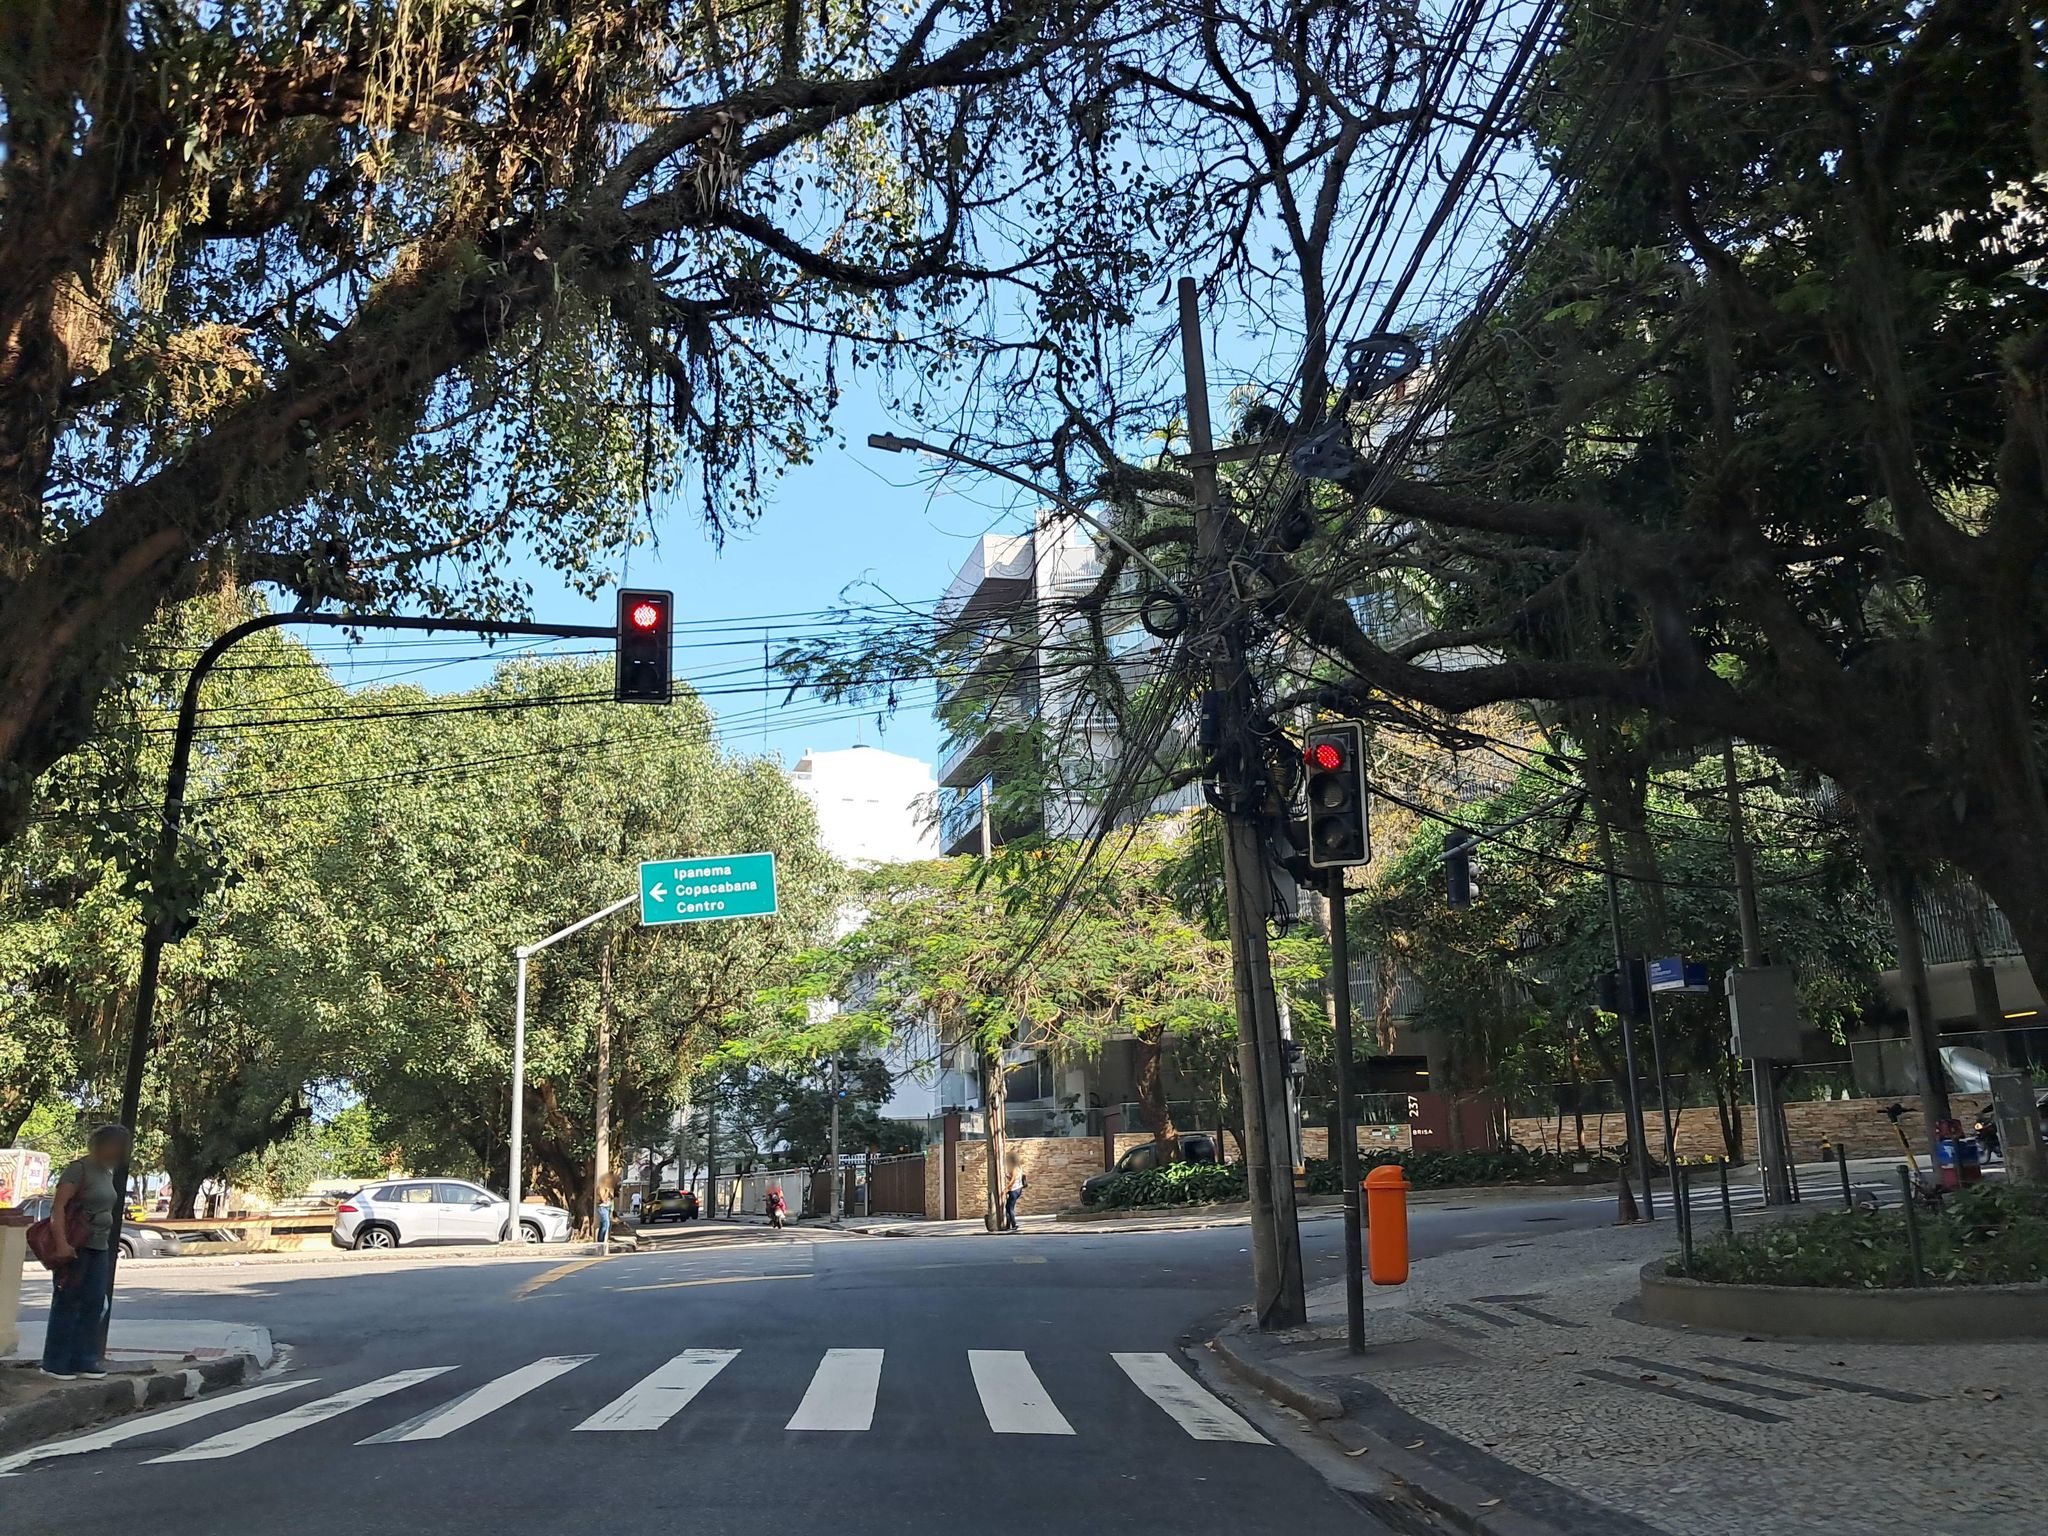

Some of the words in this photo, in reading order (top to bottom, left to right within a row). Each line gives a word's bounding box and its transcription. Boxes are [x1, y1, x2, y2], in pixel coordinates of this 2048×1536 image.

[674, 866, 732, 881] Ipanema
[675, 880, 758, 897] Copacabana
[676, 900, 725, 914] Centro
[1408, 1095, 1419, 1117] 237
